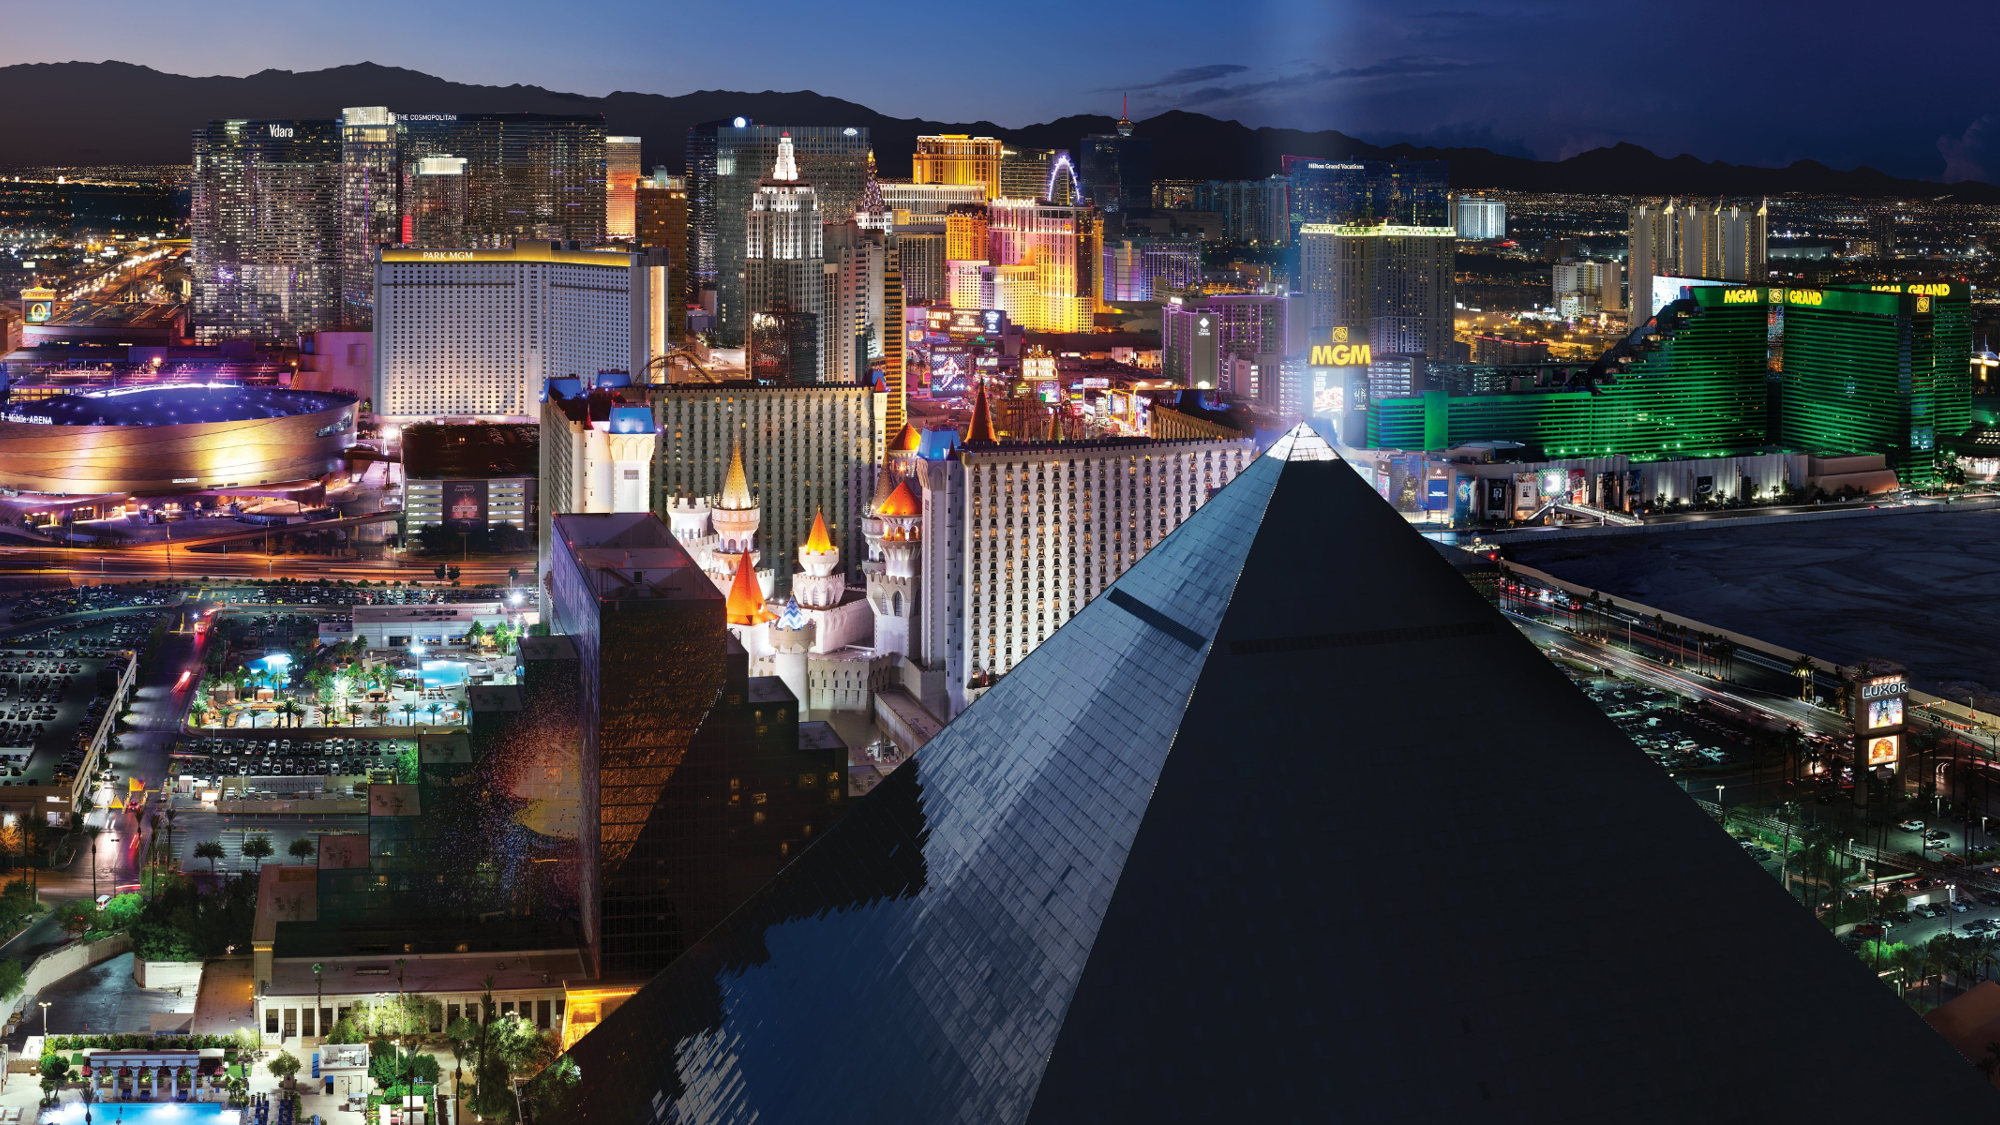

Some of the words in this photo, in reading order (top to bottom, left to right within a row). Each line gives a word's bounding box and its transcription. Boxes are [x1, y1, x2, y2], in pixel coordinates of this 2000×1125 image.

[269, 124, 294, 138] Vdara
[992, 196, 1035, 210] hollywood
[423, 252, 447, 260] PARK
[449, 252, 474, 260] MGM
[1723, 289, 1758, 304] MGM
[1789, 290, 1823, 306] GRAND
[1907, 284, 1951, 297] GRAND
[1311, 344, 1371, 366] MGM
[30, 415, 53, 425] ARENA
[1862, 682, 1909, 699] LUXOR
